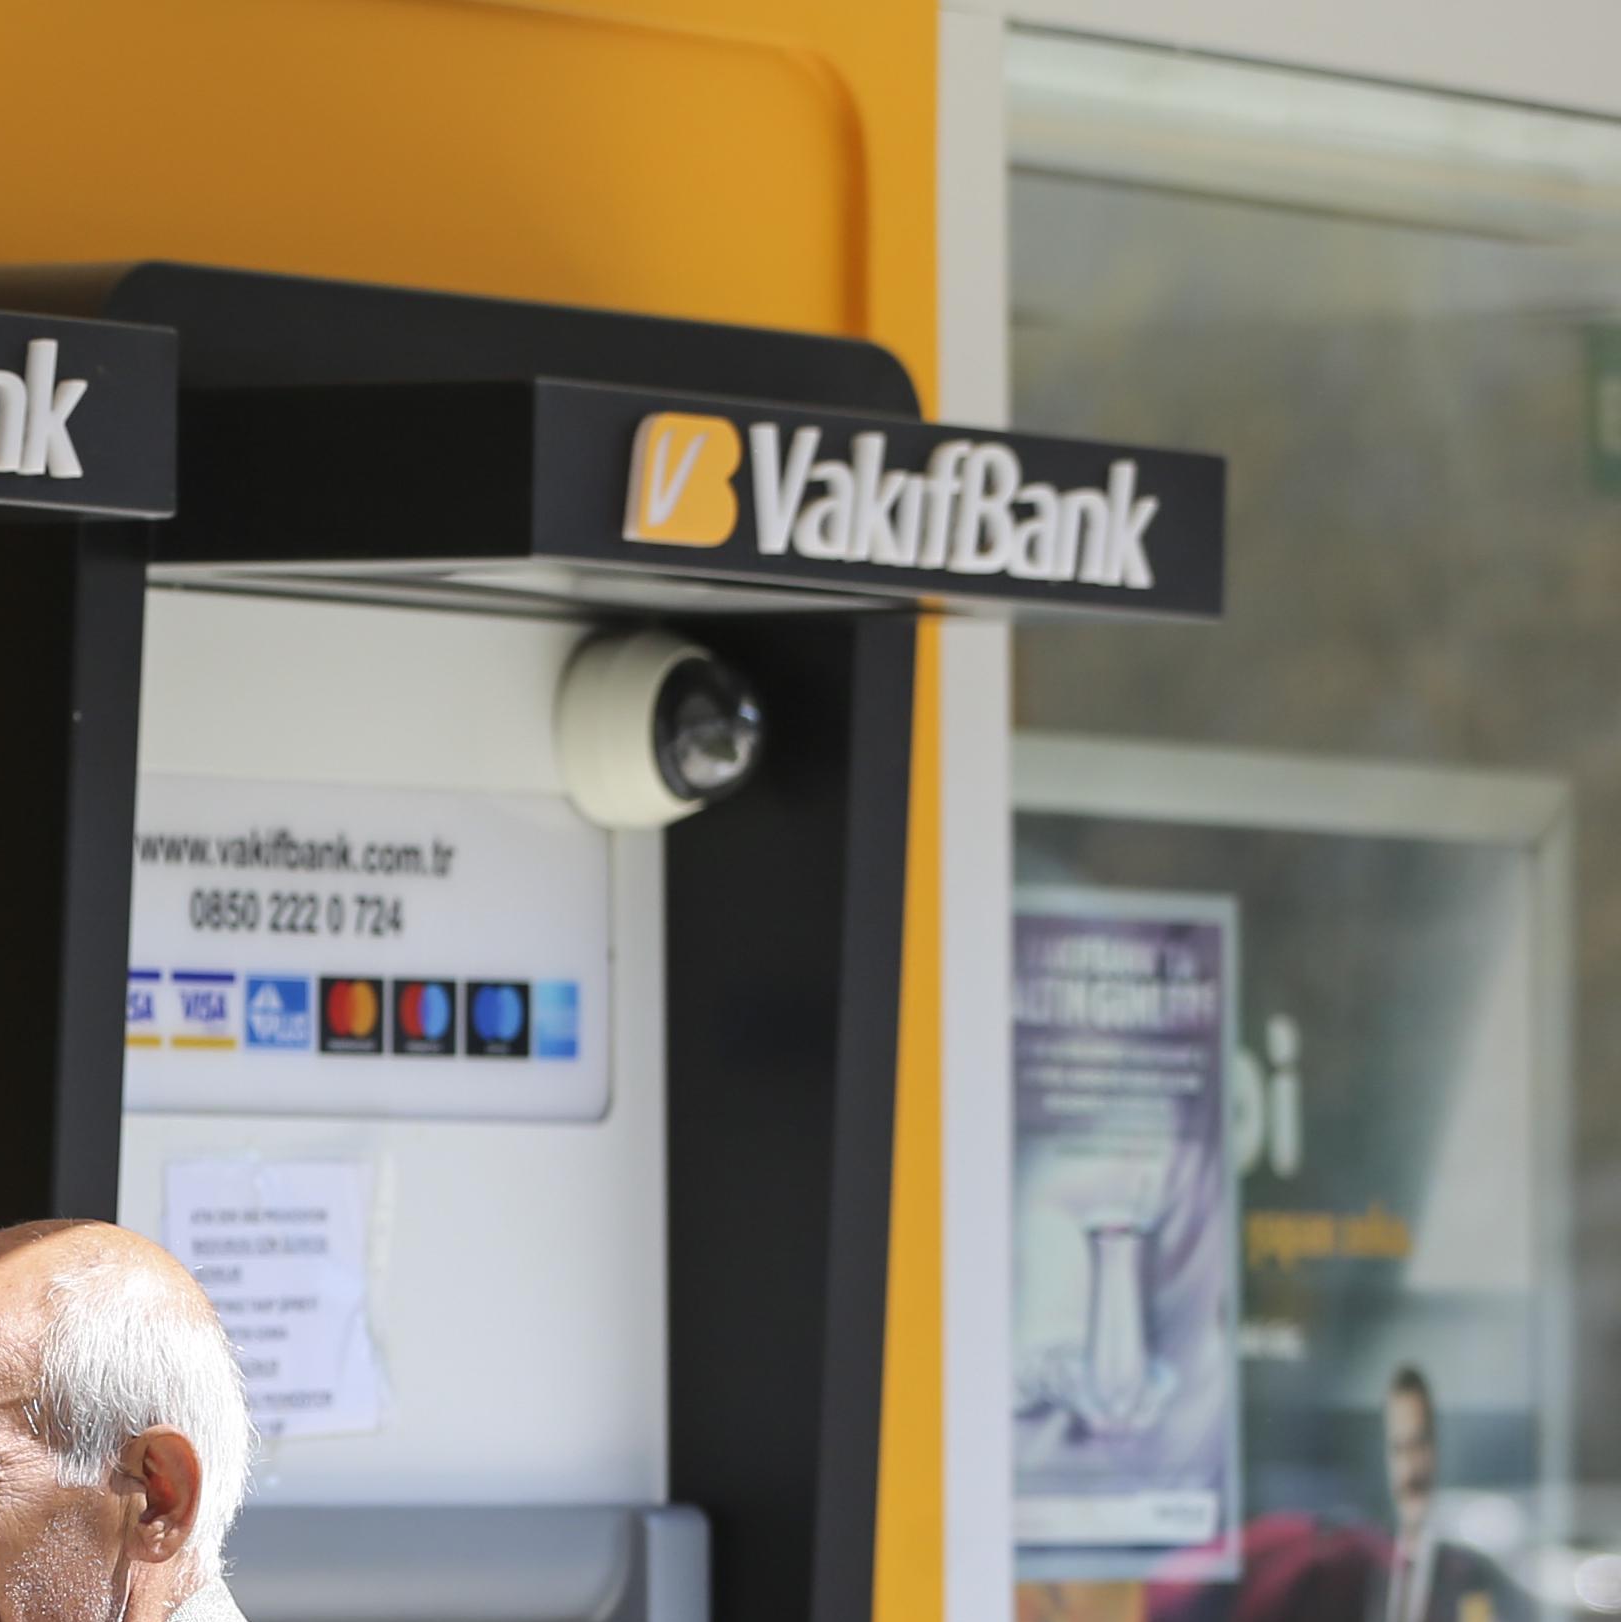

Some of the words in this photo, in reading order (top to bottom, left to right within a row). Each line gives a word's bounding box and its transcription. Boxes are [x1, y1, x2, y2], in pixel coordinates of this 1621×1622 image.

[749, 422, 1158, 589] VakıfBank
[134, 831, 455, 878] www.vakifbank.com.tr
[189, 887, 258, 932] 0850
[267, 891, 318, 934] 222
[325, 894, 345, 935] 0
[354, 895, 405, 938] 724
[180, 991, 226, 1021] VISA
